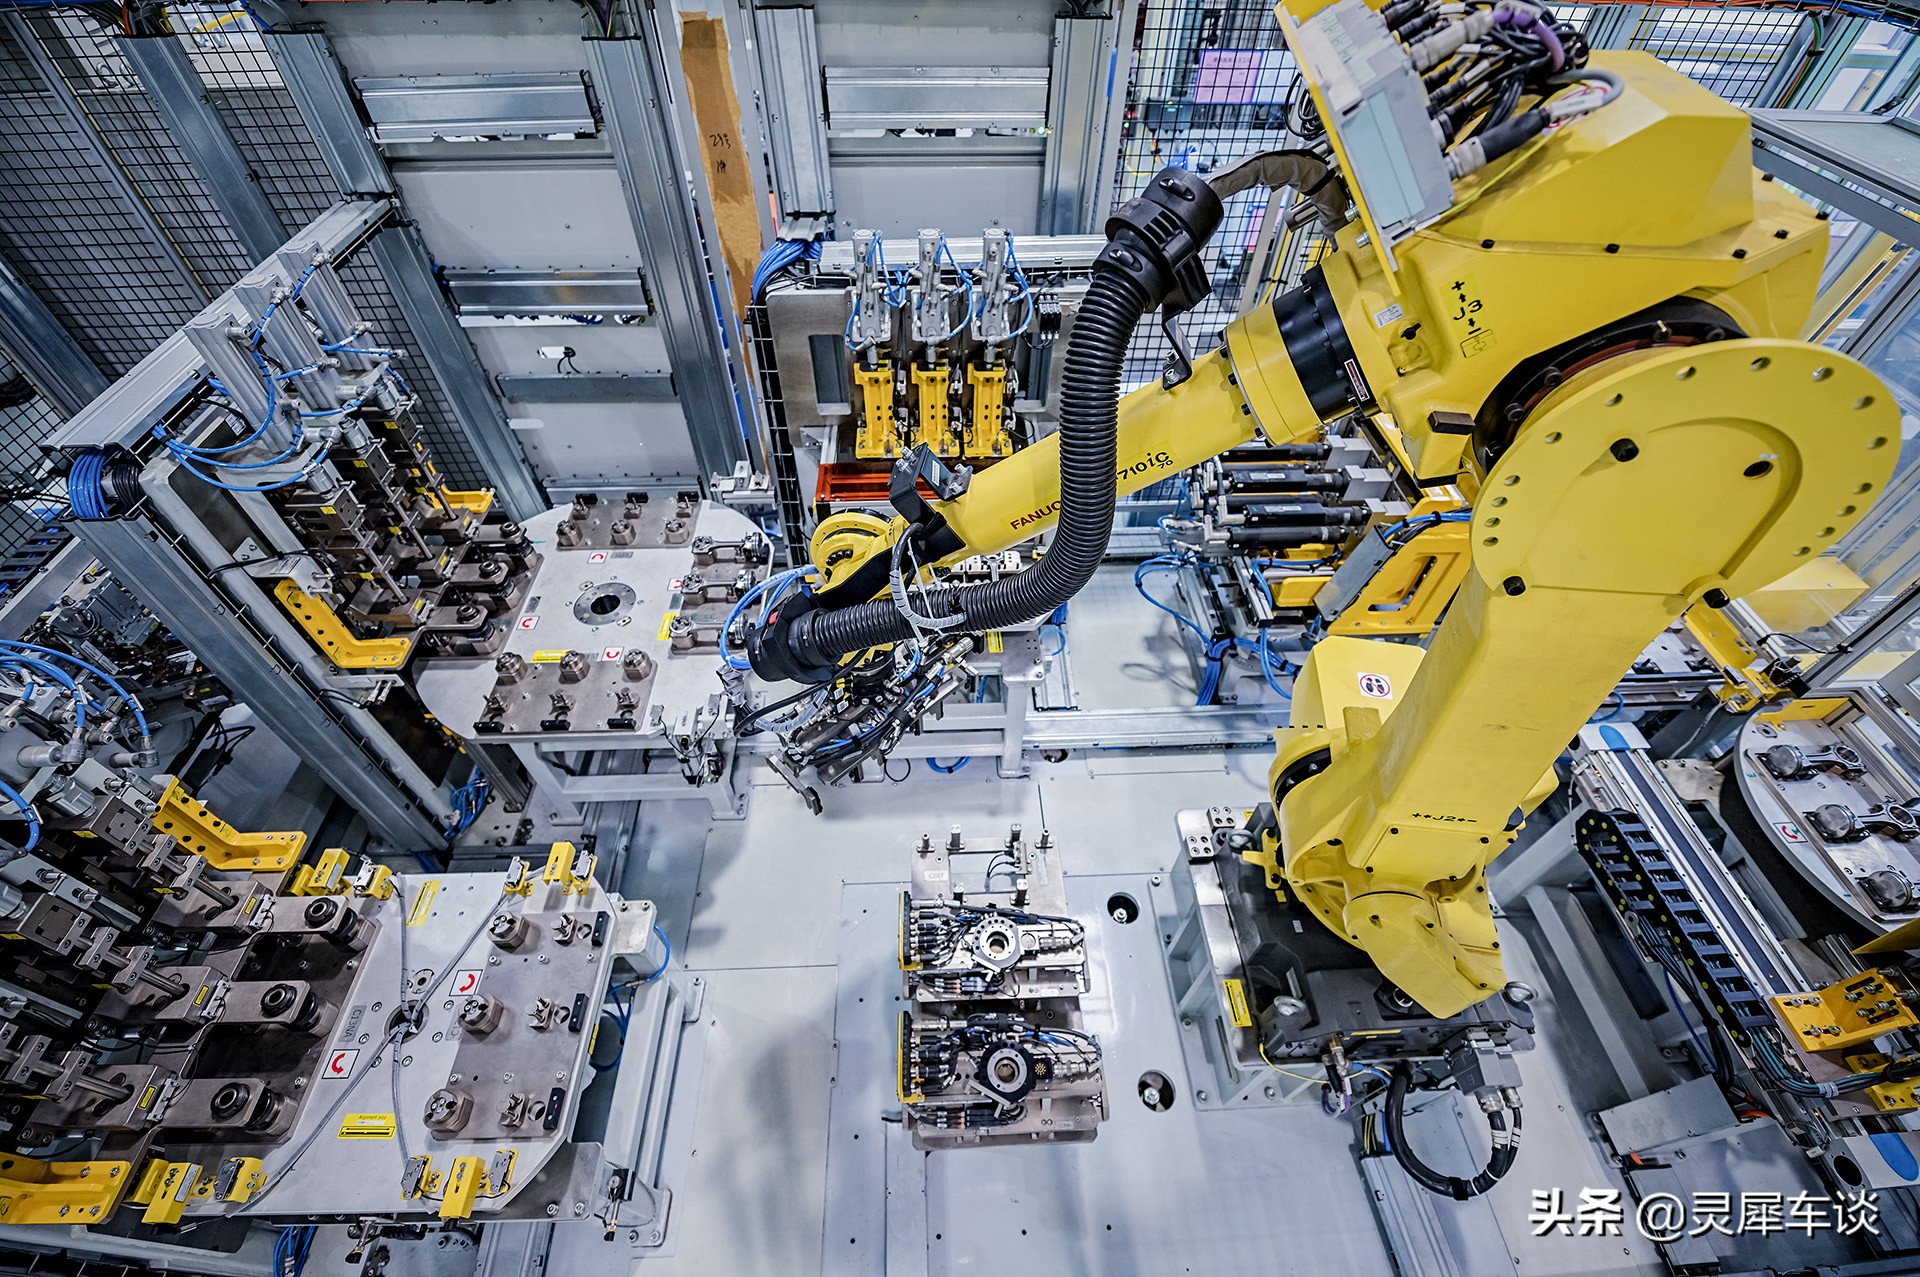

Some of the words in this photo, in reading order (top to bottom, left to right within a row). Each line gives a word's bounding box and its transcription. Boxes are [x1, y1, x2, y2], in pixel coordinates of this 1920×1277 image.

[1116, 451, 1170, 480] 710iC
[1009, 500, 1061, 530] FANUC
[342, 1008, 362, 1039] C13NA
